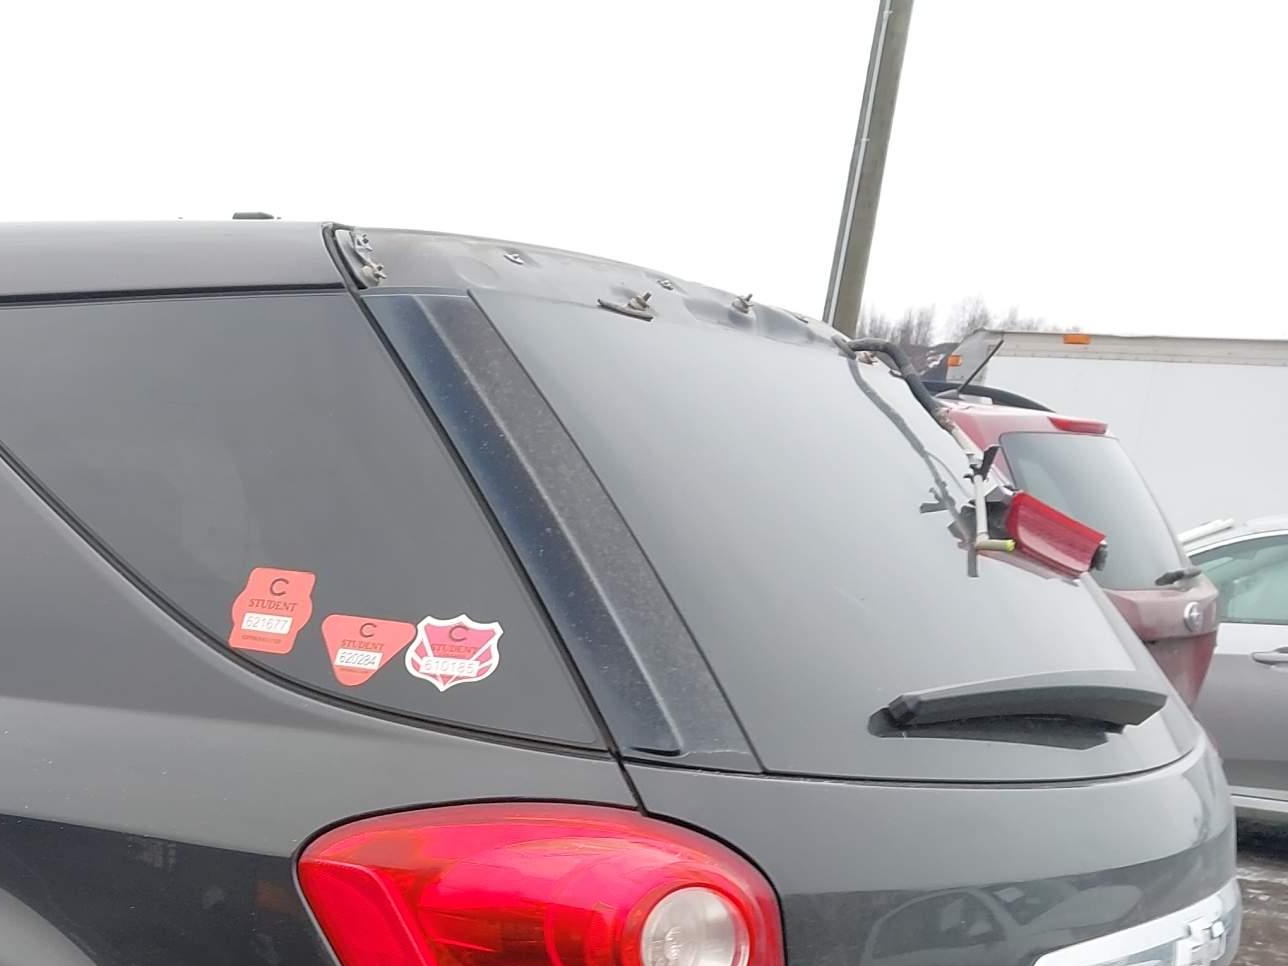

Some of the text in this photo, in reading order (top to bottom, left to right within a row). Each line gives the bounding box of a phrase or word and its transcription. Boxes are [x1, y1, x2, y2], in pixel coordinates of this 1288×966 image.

[269, 577, 289, 597] C
[248, 598, 298, 612] STUDENT
[359, 622, 377, 638] C
[341, 639, 384, 650] STUDENT
